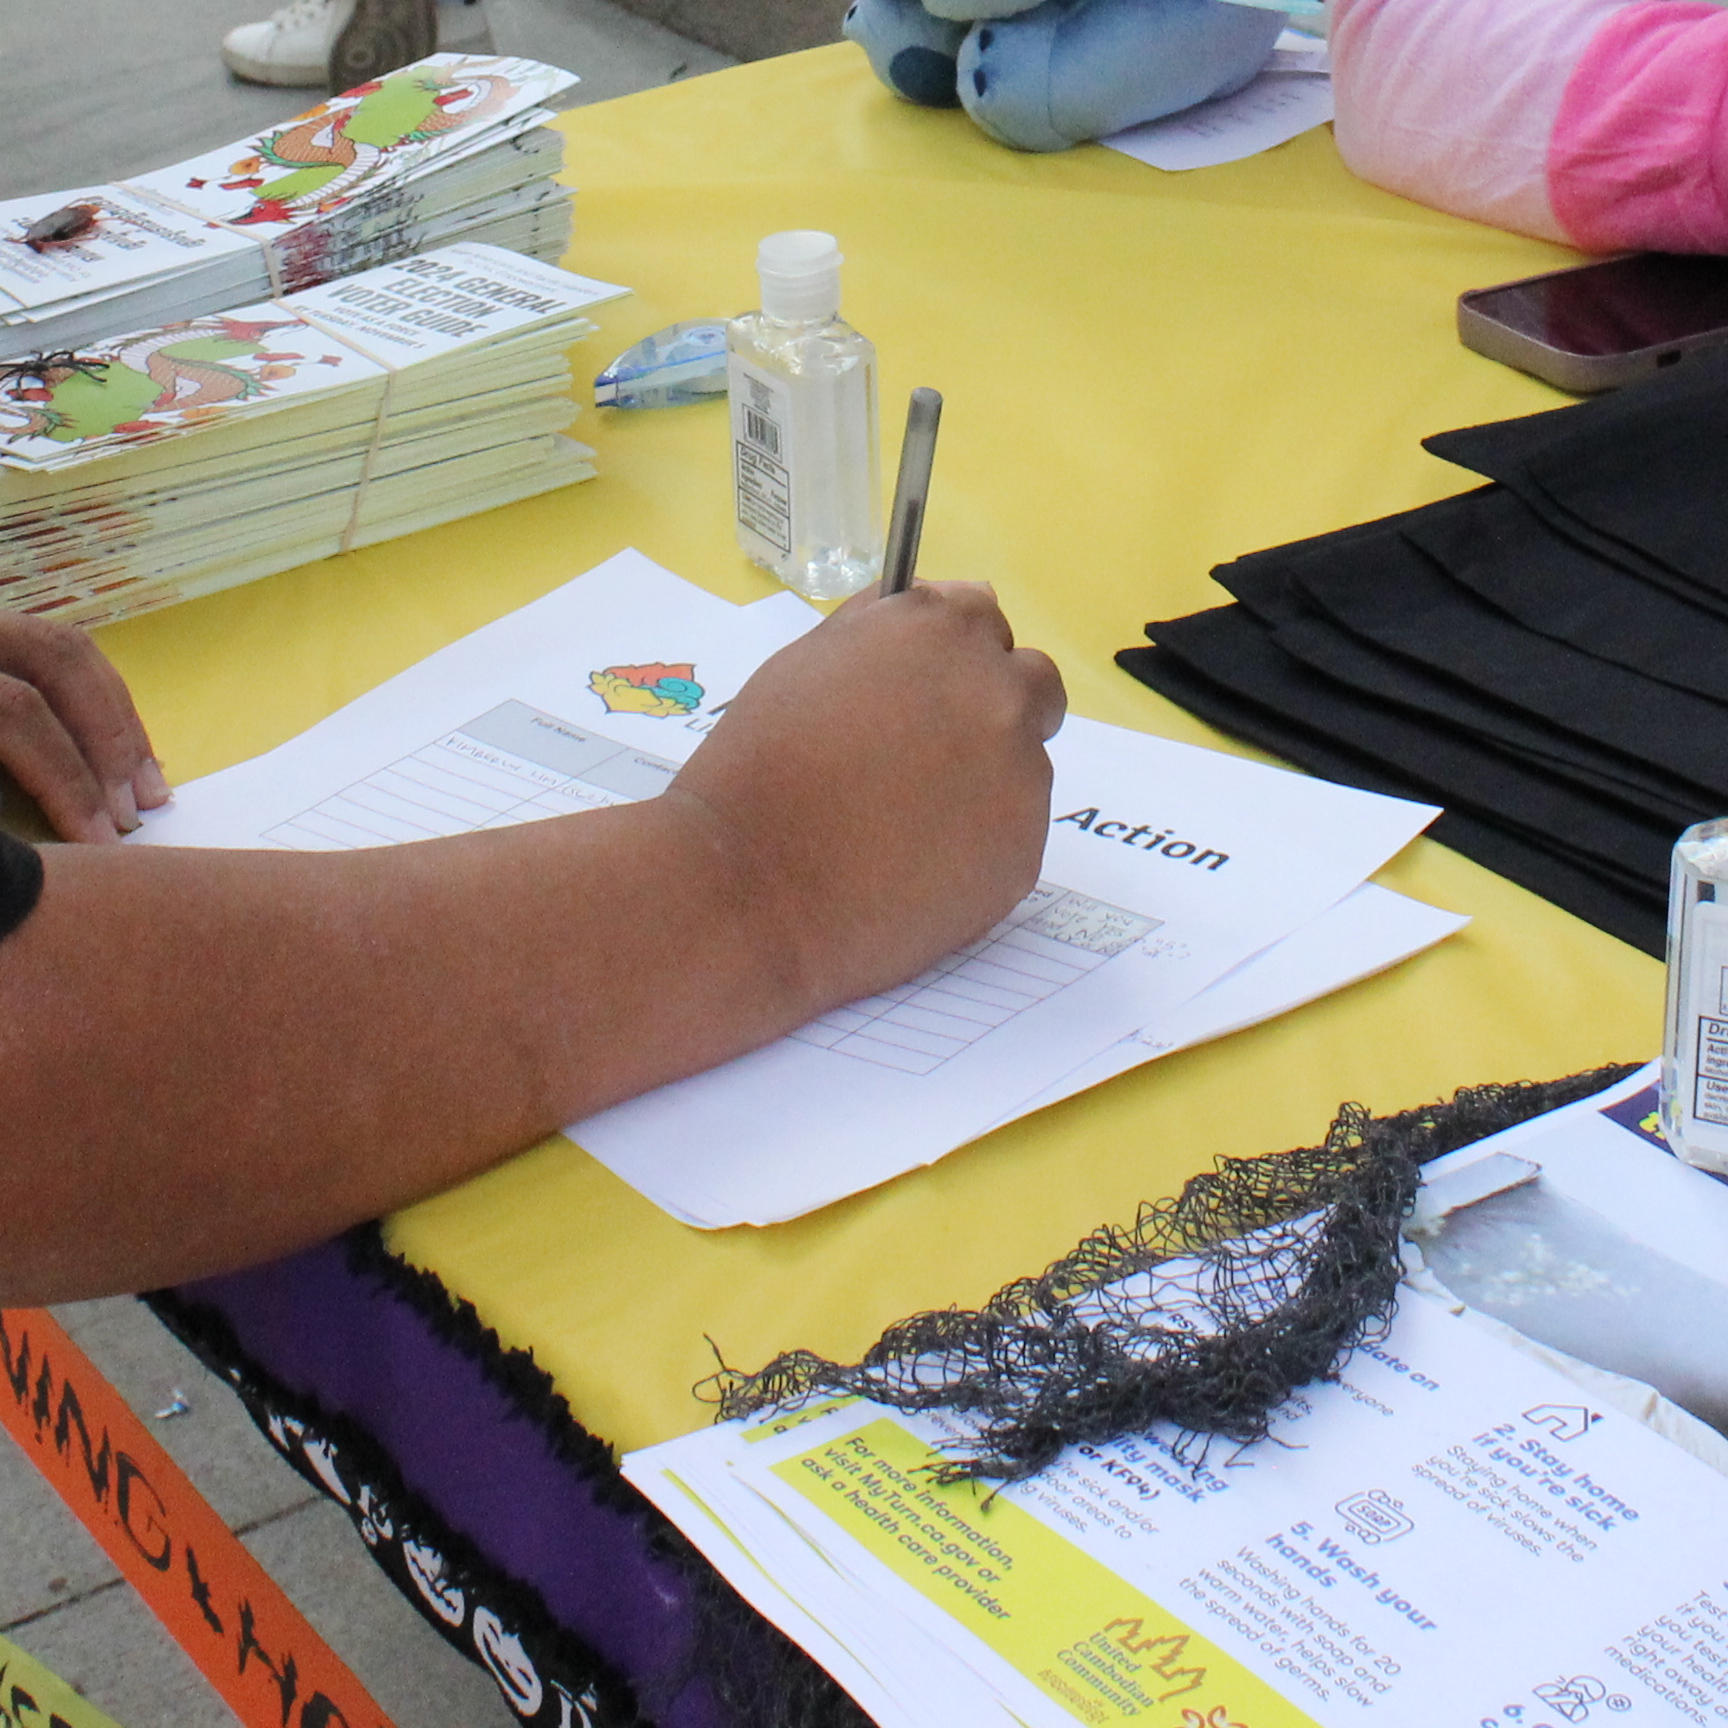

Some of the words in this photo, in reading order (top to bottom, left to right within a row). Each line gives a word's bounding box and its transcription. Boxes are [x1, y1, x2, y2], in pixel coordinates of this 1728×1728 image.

[327, 283, 414, 315] VOTER
[399, 308, 489, 337] GUIDE
[382, 276, 504, 319] ELECTION
[392, 259, 468, 283] 2024
[454, 276, 568, 314] GENERAL
[1053, 806, 1230, 872] Action
[1410, 1370, 1440, 1392] on
[845, 1436, 875, 1461] For
[872, 1458, 917, 1494] more
[915, 1489, 1016, 1572] information,
[1077, 1475, 1109, 1500] sick
[1107, 1497, 1160, 1536] and/or
[1078, 1445, 1103, 1461] or
[1100, 1457, 1161, 1501] KF94)
[1143, 1461, 1208, 1504] mask
[1446, 1444, 1508, 1489] Staying
[1507, 1483, 1553, 1520] home
[1554, 1516, 1598, 1552] when
[1488, 1447, 1566, 1497] you're
[1565, 1495, 1617, 1532] sick
[1492, 1423, 1516, 1441] 2.
[1519, 1438, 1575, 1478] Stay
[1573, 1473, 1639, 1522] home
[800, 1456, 836, 1482] ask
[831, 1479, 848, 1492] a
[844, 1489, 900, 1535] health
[898, 1532, 938, 1566] care
[932, 1564, 1012, 1621] provider
[824, 1447, 863, 1476] visit
[857, 1472, 981, 1569] MyTurn.ca.gov
[977, 1566, 1002, 1585] or
[1037, 1489, 1089, 1534] viruses.
[1071, 1495, 1115, 1528] areas
[1114, 1521, 1133, 1540] to
[1411, 1463, 1470, 1502] spread
[1466, 1499, 1490, 1514] of
[1487, 1512, 1543, 1557] viruses.
[1425, 1455, 1478, 1489] you're
[1477, 1486, 1511, 1511] sick
[1510, 1508, 1556, 1544] slows
[1555, 1538, 1584, 1563] the
[1265, 1531, 1338, 1589] hands
[1289, 1519, 1315, 1541] 5.
[1316, 1537, 1383, 1590] Wash
[1375, 1587, 1437, 1632] your
[1198, 1567, 1243, 1604] warm
[1243, 1601, 1290, 1643] water,
[1291, 1638, 1337, 1679] helps
[1334, 1676, 1374, 1707] slow
[1216, 1558, 1281, 1608] seconds
[1279, 1605, 1316, 1636] with
[1313, 1633, 1355, 1667] soap
[1353, 1666, 1392, 1694] and
[1236, 1544, 1302, 1601] Washing
[1300, 1595, 1351, 1638] hands
[1350, 1634, 1376, 1656] for
[1374, 1654, 1402, 1677] 20
[1675, 1601, 1696, 1617] if
[1687, 1615, 1726, 1643] you
[1693, 1588, 1728, 1621] Test
[1089, 1632, 1142, 1673] United
[1179, 1576, 1207, 1601] the
[1204, 1599, 1265, 1643] spread
[1260, 1639, 1286, 1658] of
[1274, 1654, 1331, 1703] germs.
[1623, 1633, 1667, 1669] right
[1664, 1666, 1714, 1708] away
[1637, 1624, 1683, 1656] your
[1655, 1613, 1693, 1642] you
[1692, 1638, 1728, 1668] test
[1057, 1649, 1141, 1716] Community
[1073, 1640, 1155, 1708] Cambodian
[1603, 1643, 1709, 1728] medications.
[1503, 1703, 1526, 1724] 6.
